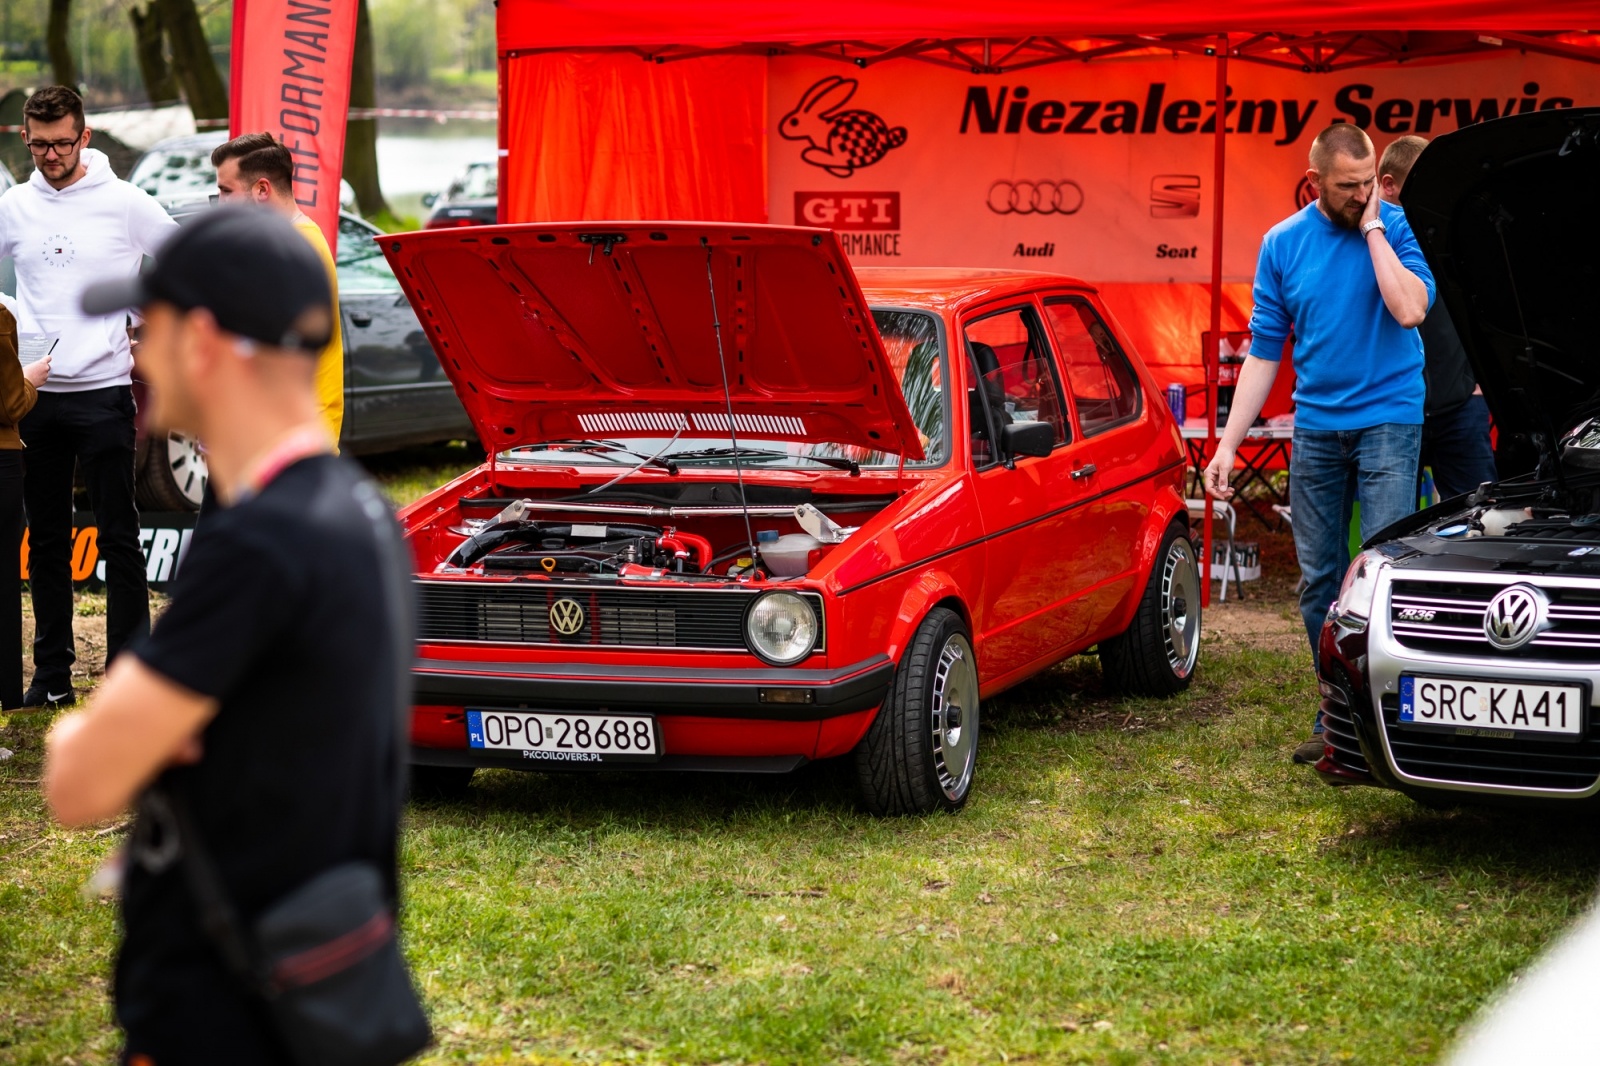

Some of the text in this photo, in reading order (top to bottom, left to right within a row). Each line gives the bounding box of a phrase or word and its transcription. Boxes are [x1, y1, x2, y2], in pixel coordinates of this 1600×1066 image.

[959, 83, 1318, 146] Niezależny
[803, 198, 890, 223] GTI
[838, 233, 901, 256] RMANCE
[1013, 242, 1055, 258] Audi
[1156, 244, 1197, 259] Seat
[1402, 703, 1413, 714] PL
[1420, 683, 1566, 728] SRC KA41
[471, 733, 482, 742] PL
[485, 715, 651, 750] OPO 28688
[523, 750, 602, 762] PKCOILOVERS.PL
